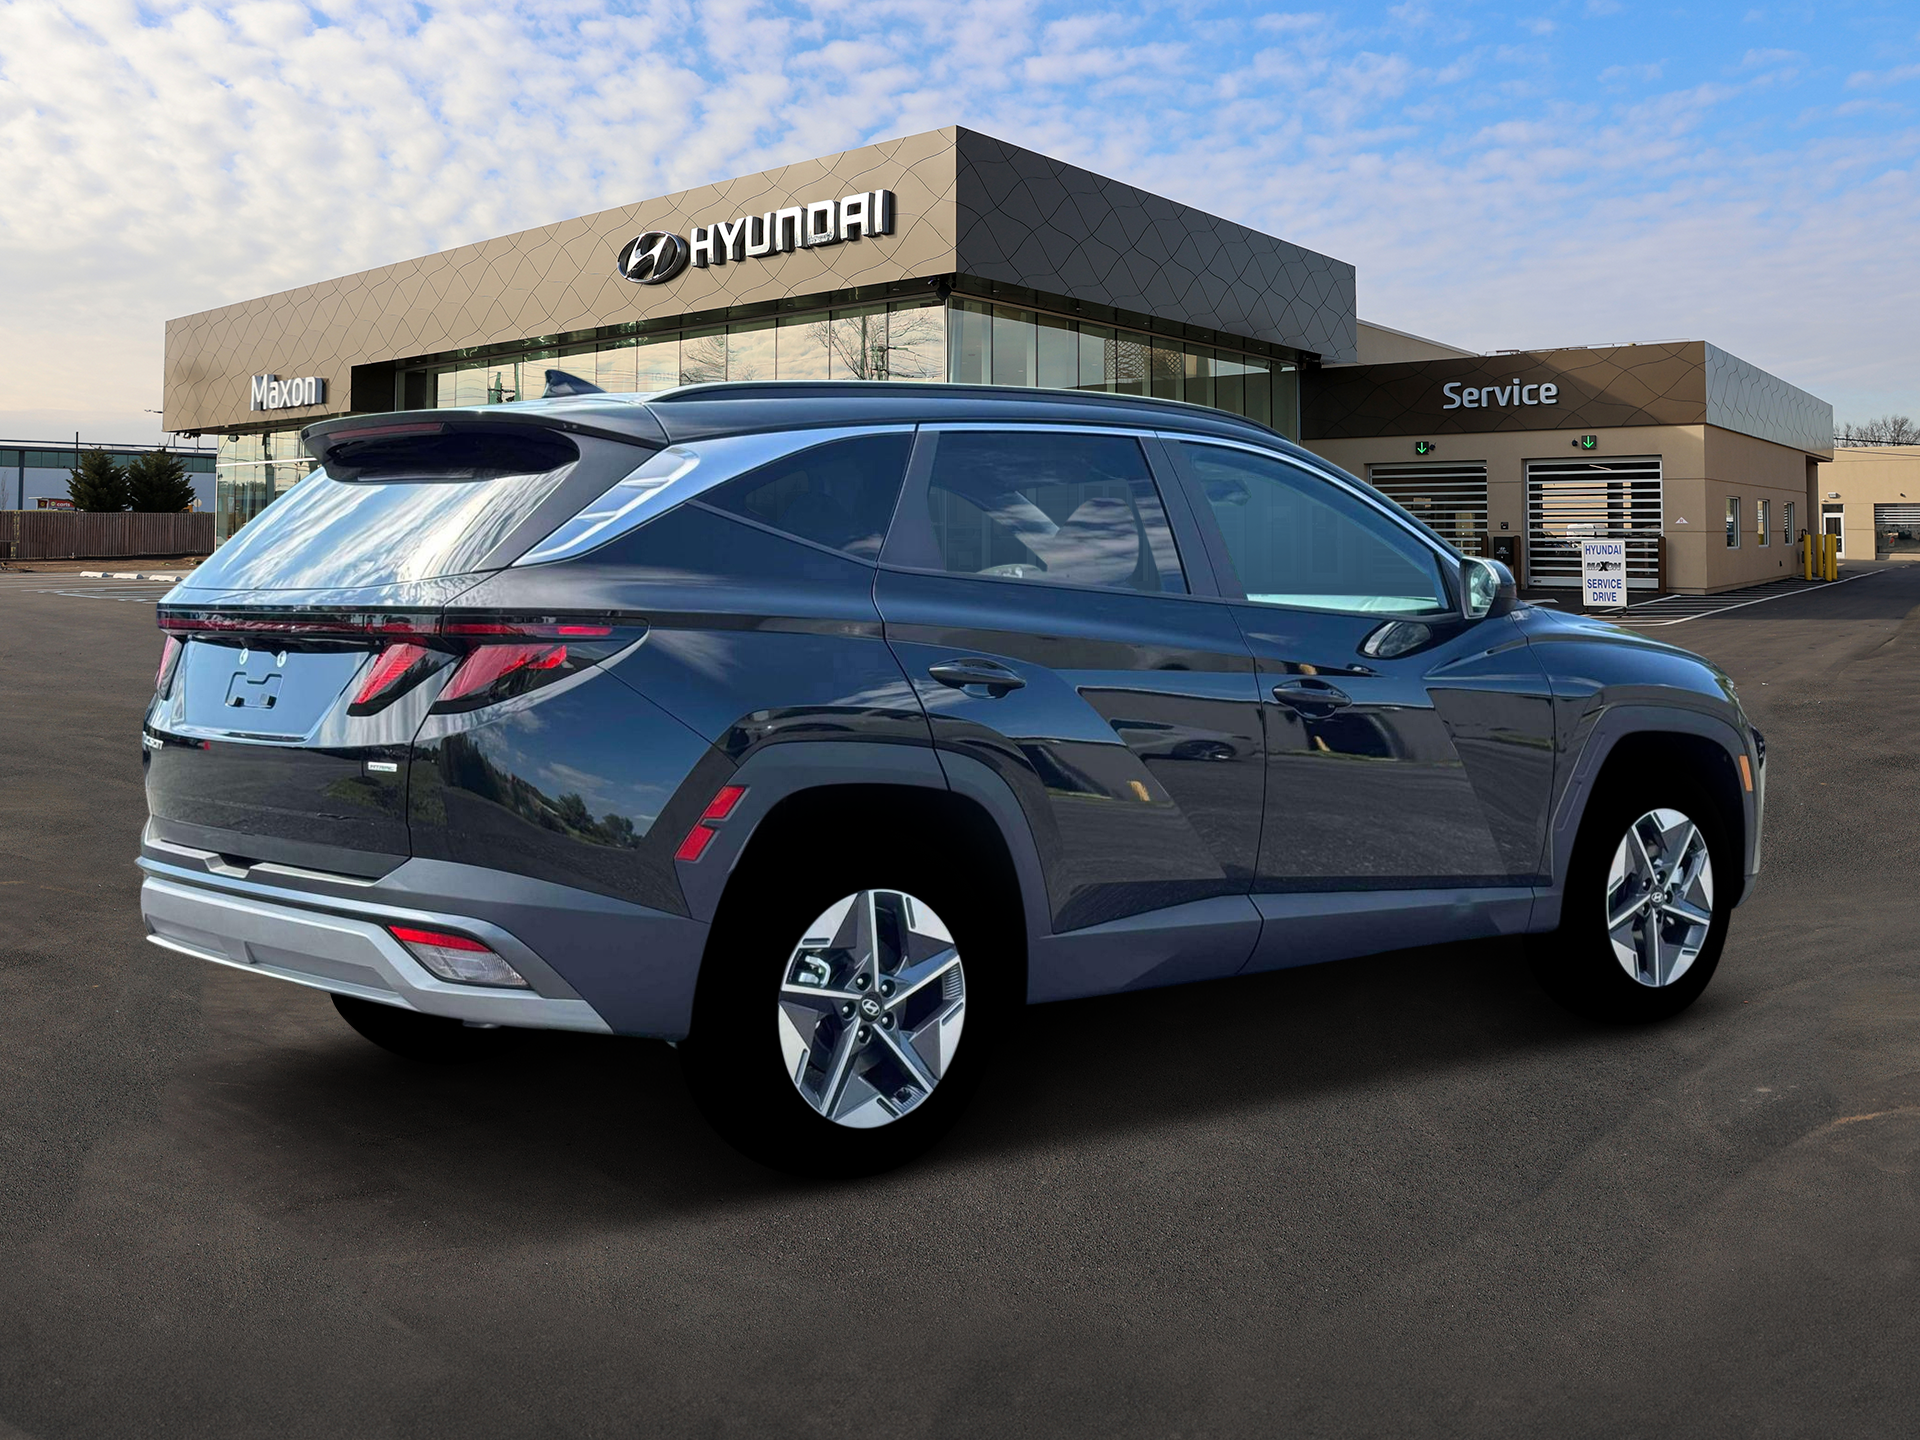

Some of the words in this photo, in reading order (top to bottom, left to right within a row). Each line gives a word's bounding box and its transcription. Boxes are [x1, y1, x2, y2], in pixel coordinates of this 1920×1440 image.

[690, 188, 893, 268] HYUNDAI
[250, 373, 318, 411] Maxon
[1442, 377, 1559, 410] Service
[1585, 544, 1622, 555] HYUNDAI
[1586, 561, 1622, 572] MAXON
[1586, 578, 1622, 589] SERVICE
[1592, 591, 1617, 602] DRIVE
